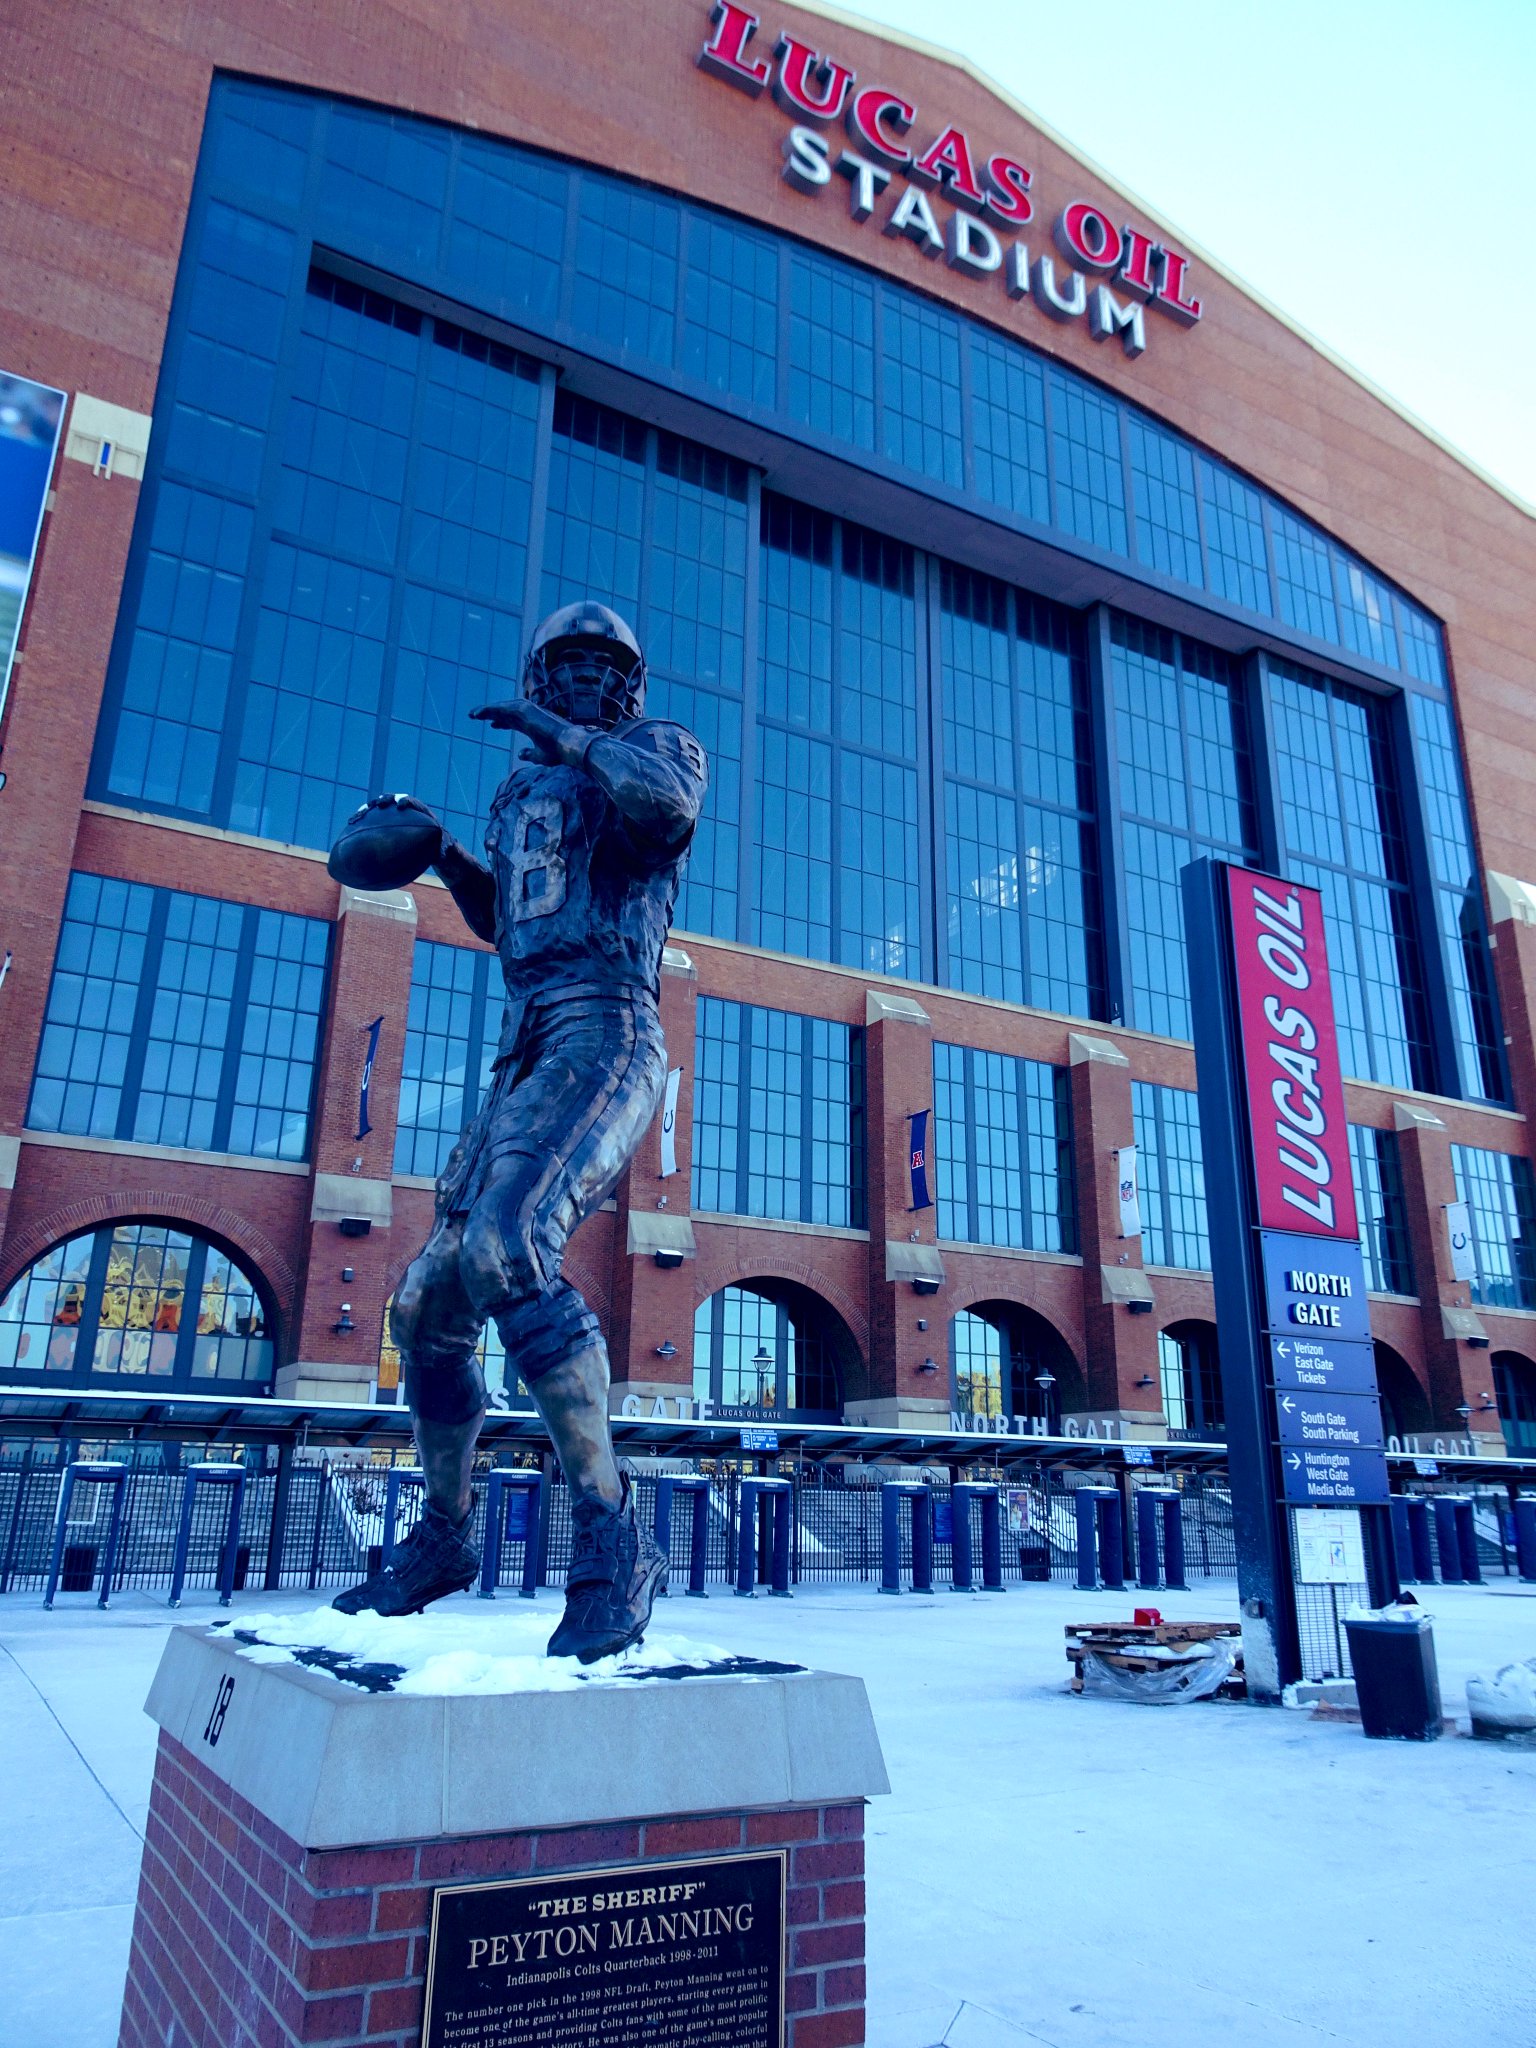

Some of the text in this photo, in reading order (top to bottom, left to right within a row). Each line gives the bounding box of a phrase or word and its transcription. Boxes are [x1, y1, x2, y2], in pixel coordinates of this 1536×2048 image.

[702, 0, 1203, 320] LUCAS OIL
[785, 125, 1146, 354] STADIUM
[1253, 885, 1336, 1230] LUCAS OIL
[1291, 1270, 1352, 1298] NORTH
[1295, 1302, 1342, 1328] GATE
[1294, 1341, 1324, 1356] Verizon
[1295, 1356, 1334, 1371] East Gate
[1296, 1370, 1326, 1384] Tickets
[621, 1394, 714, 1421] GATE
[718, 1408, 743, 1416] LUCAS
[951, 1412, 1049, 1436] NORTH
[1301, 1411, 1346, 1426] South Gate
[127, 1427, 134, 1439] 1
[1302, 1426, 1360, 1443] South Parking
[857, 1454, 863, 1463] 4
[1035, 1460, 1042, 1469] 5
[1304, 1452, 1350, 1467] Huntington
[1192, 1466, 1197, 1474] 6
[1306, 1468, 1348, 1482] West Gate
[1308, 1483, 1355, 1496] Media Gate
[204, 1674, 235, 1747] 18
[466, 1903, 754, 1969] PEYTON MANNING
[506, 1966, 571, 1987] Indianapolis
[574, 1962, 601, 1977] Colts
[604, 1952, 666, 1973] Quarterback
[444, 1965, 768, 2022] The number one pick in the 1998 NFL Draft, Peyton Manning went on to
[444, 1980, 768, 2039] become one of the game's all-time greatest players, starting every game in
[484, 2038, 494, 2048] 13
[497, 2033, 533, 2047] seasons
[536, 2027, 553, 2040] and
[555, 2022, 598, 2039] providing
[600, 2017, 623, 2029] Colts
[626, 2015, 644, 2026] fans
[646, 2010, 664, 2021] with
[667, 2008, 689, 2018] some
[691, 2004, 700, 2014] of
[702, 2003, 715, 2013] the
[717, 1999, 737, 2010] most
[739, 1994, 768, 2008] prolific
[588, 2036, 600, 2048] He
[603, 2035, 619, 2044] was
[621, 2030, 639, 2042] also
[641, 2029, 657, 2038] one
[659, 2024, 668, 2035] of
[670, 2023, 684, 2034] the
[686, 2018, 714, 2032] game's
[717, 2014, 736, 2026] most
[738, 2010, 768, 2024] popular
[735, 2023, 768, 2038] colorful
